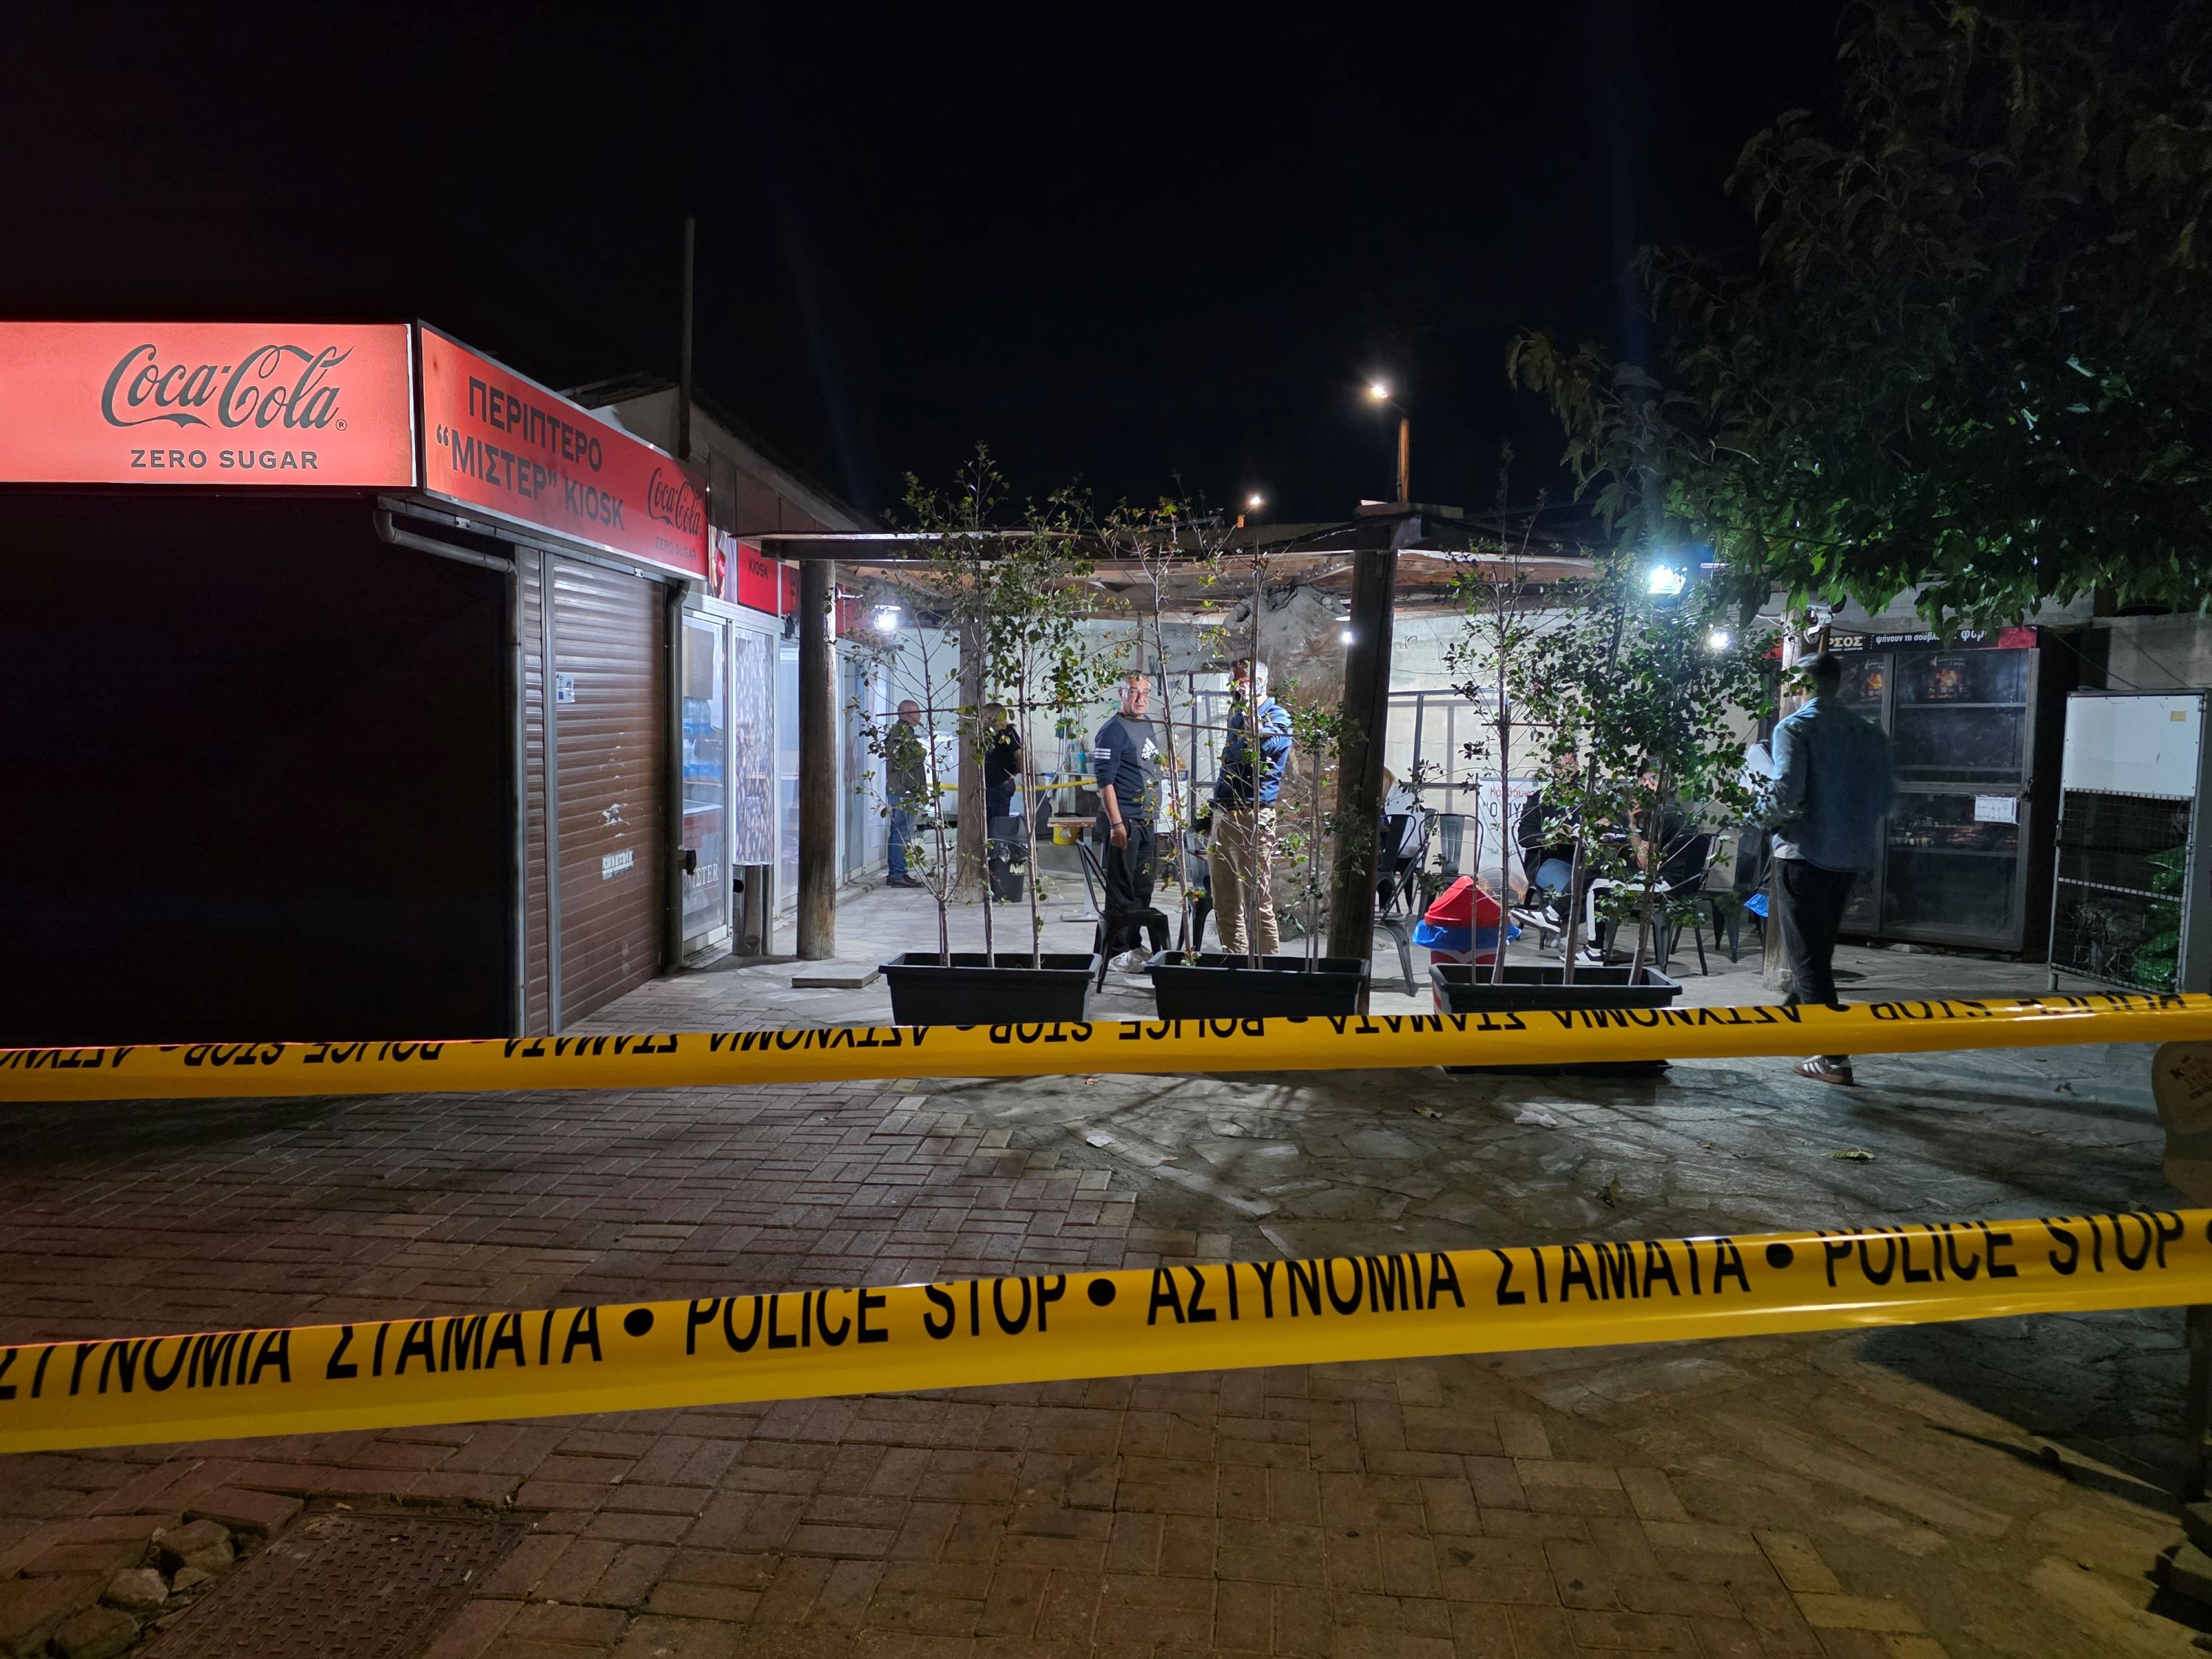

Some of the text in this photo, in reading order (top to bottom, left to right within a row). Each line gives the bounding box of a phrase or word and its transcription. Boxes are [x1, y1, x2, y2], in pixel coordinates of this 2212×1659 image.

[102, 344, 354, 429] Coca-Cola
[468, 375, 602, 473] ΠΕΡΙΠΤΕΡΟ
[131, 449, 318, 470] ZERO SUGAR
[564, 476, 625, 531] KIOSK
[647, 467, 703, 537] Coca-Cola
[655, 536, 697, 560] ZERO SUGAR
[748, 557, 768, 580] KIOSK
[326, 1306, 603, 1380] ΣΤΑΜΑΤΑ
[686, 1287, 888, 1354] POLICE
[923, 1274, 1066, 1339] STOP
[1147, 1251, 1465, 1325] ΑΣΤΥΝΟΜΙΑ
[1494, 1238, 1751, 1305] ΣΤΑΜΑΤΑ
[1816, 1220, 2020, 1287] POLICE
[2039, 1211, 2184, 1275] STOP
